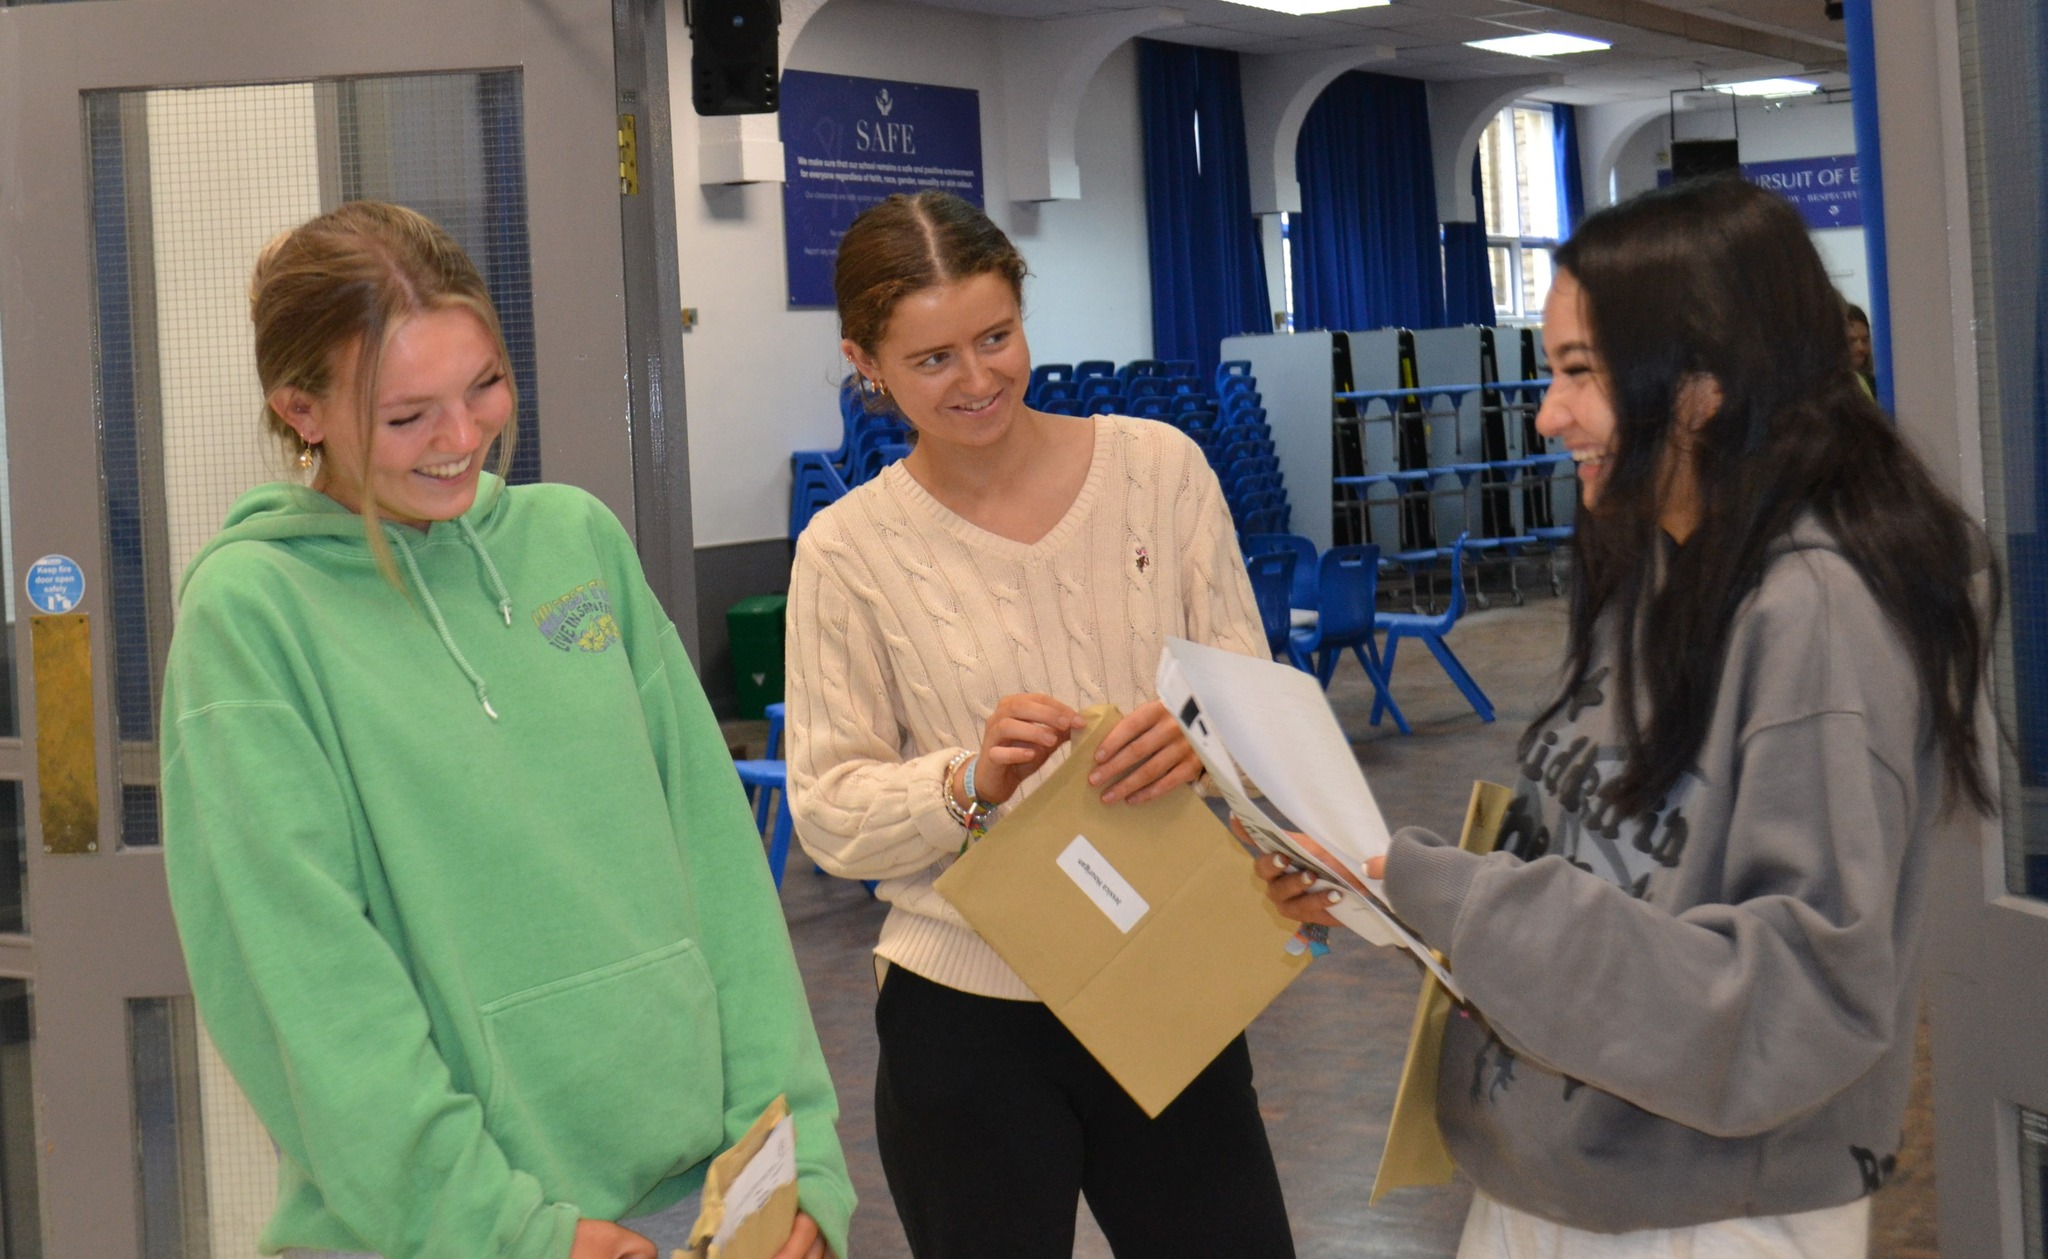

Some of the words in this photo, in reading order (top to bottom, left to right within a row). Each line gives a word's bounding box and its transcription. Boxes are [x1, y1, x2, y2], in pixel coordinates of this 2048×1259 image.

[856, 119, 916, 155] SAFE
[1744, 170, 1813, 190] URSUIT
[1817, 168, 1845, 186] OF
[1849, 166, 1861, 185] E
[37, 566, 57, 574] Keep
[59, 565, 72, 573] fire
[35, 576, 53, 584] door
[55, 576, 75, 584] open
[44, 585, 67, 594] safely
[548, 624, 576, 653] LIVE
[564, 611, 582, 629] IN
